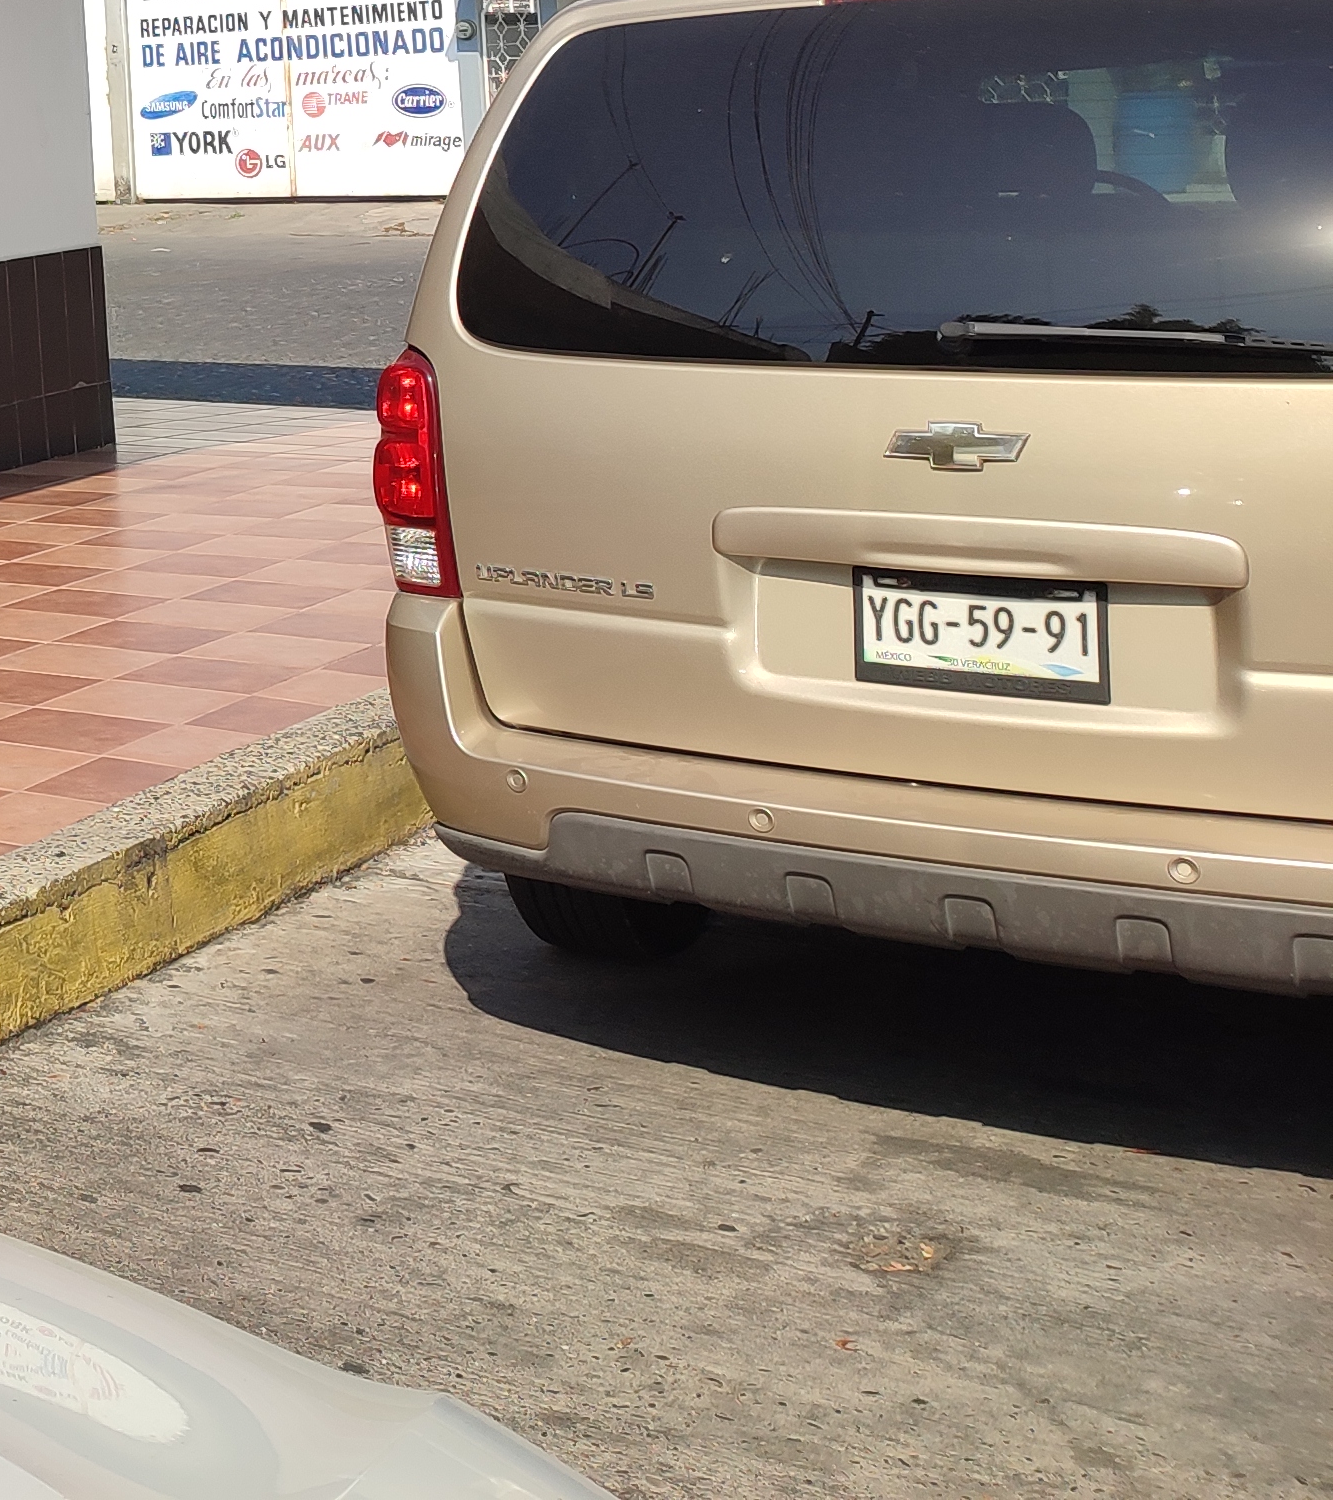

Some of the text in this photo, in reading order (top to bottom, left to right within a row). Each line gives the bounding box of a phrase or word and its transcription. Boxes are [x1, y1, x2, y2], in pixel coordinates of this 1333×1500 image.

[140, 0, 443, 38] REPARACION Y MANTENIMIENTO
[142, 27, 445, 68] DE AIRE ACONDICIONADO
[206, 67, 232, 89] En
[144, 100, 189, 113] SAMSUNG
[201, 97, 286, 119] ComfortStar
[327, 91, 368, 105] TRANE
[397, 90, 443, 108] Carrier
[172, 130, 233, 156] YORK
[298, 134, 340, 153] AUX
[410, 132, 462, 152] mirage
[266, 155, 286, 168] LG
[475, 563, 654, 599] UPLANDER LS
[867, 595, 1090, 657] YGG-59-91
[960, 659, 1011, 672] VERACRUZ
